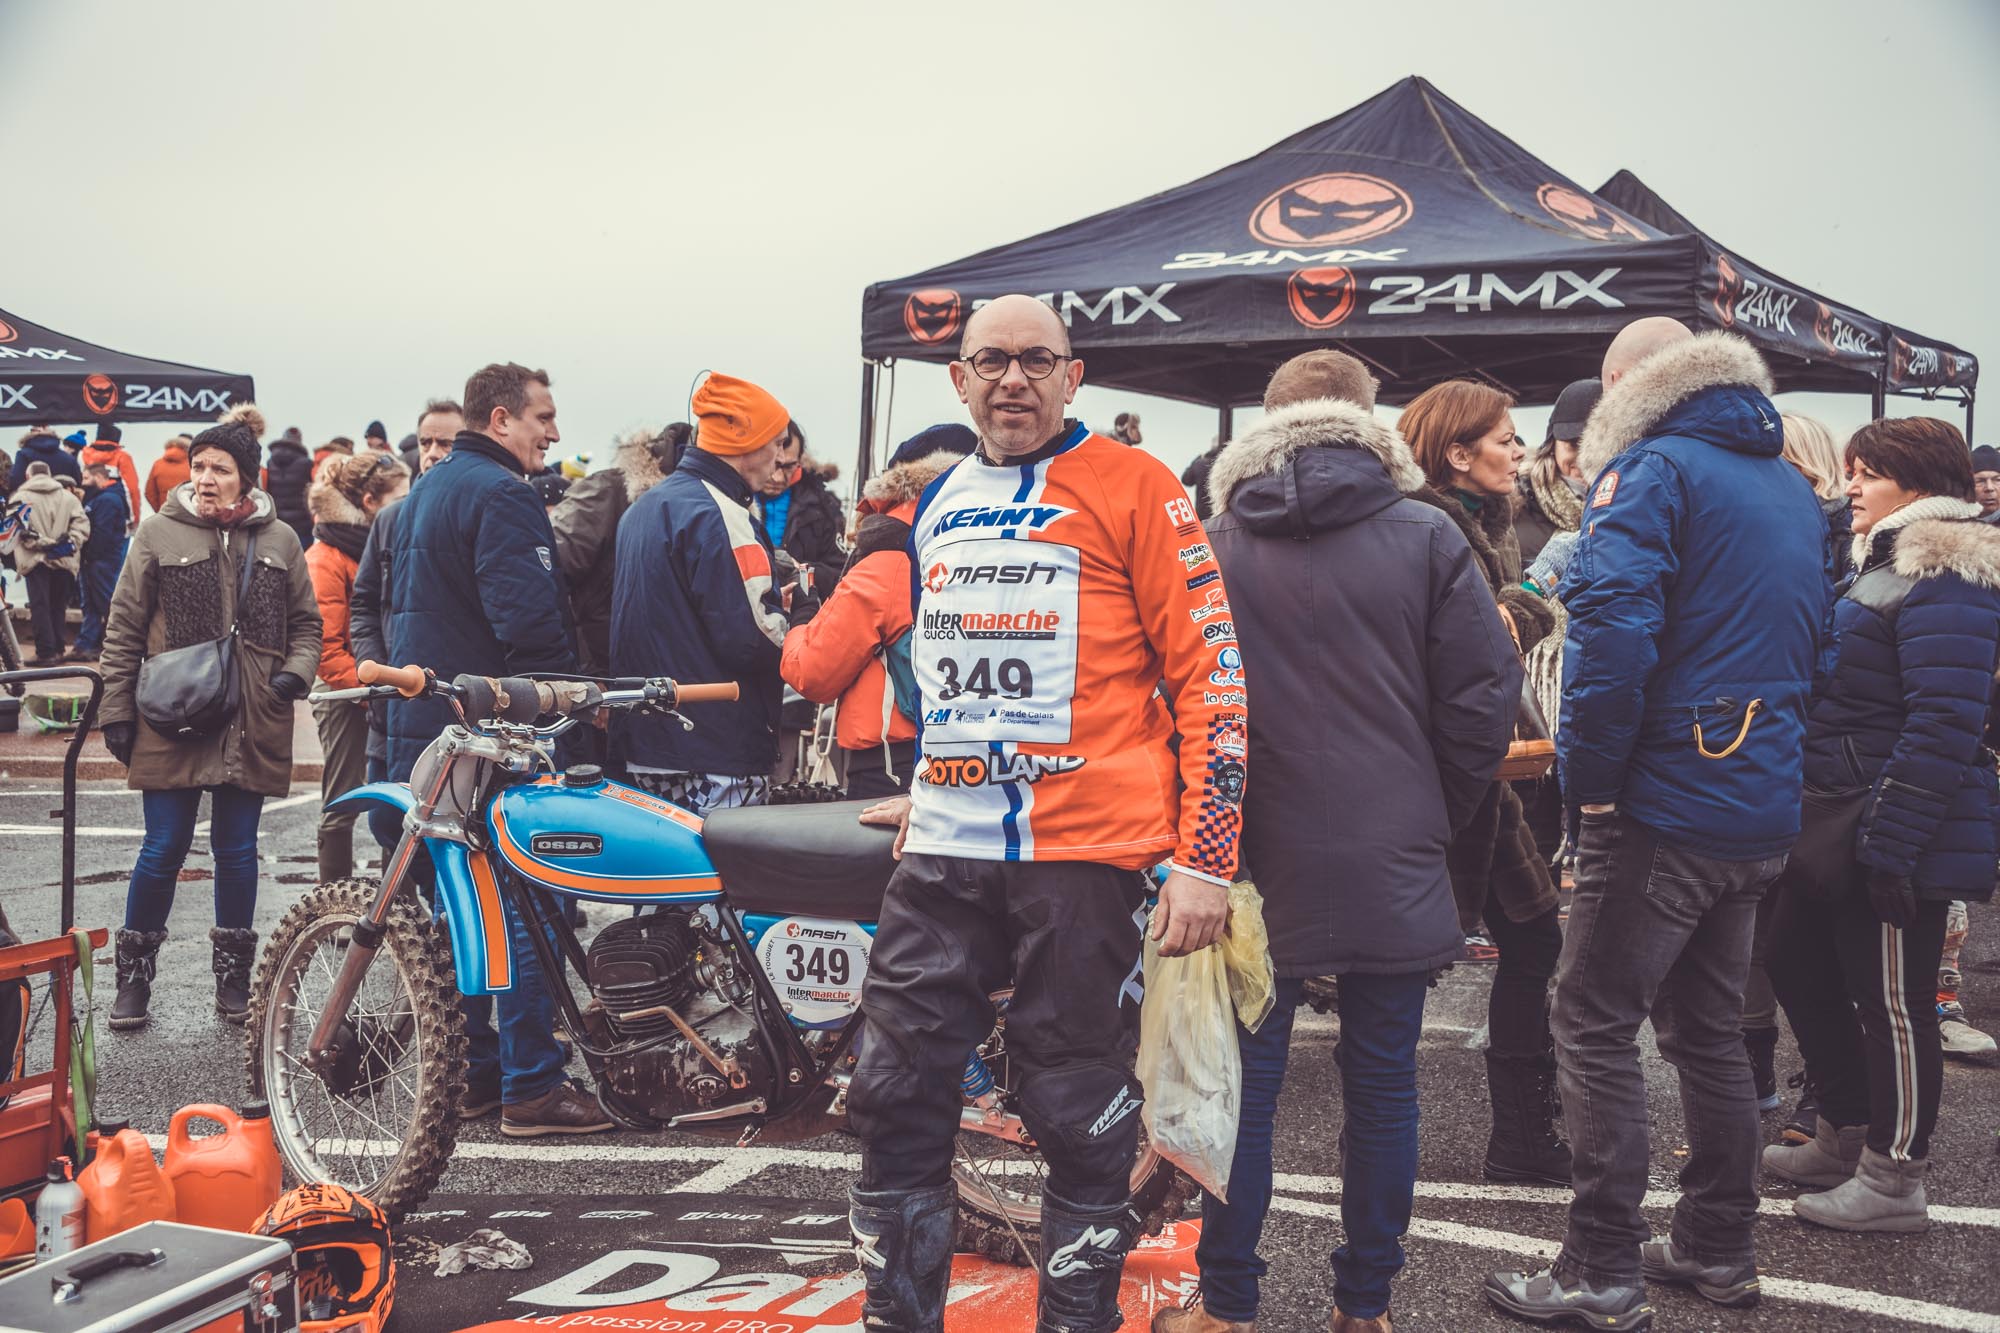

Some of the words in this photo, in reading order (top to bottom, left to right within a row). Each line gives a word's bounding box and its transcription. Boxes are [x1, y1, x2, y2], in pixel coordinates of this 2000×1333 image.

[1162, 248, 1408, 270] 24MX
[1367, 267, 1626, 315] 24MX
[1734, 279, 1798, 336] 24MX
[125, 384, 232, 411] 24MX
[932, 506, 1065, 538] KENNY
[923, 630, 957, 641] CUCQ
[936, 657, 1033, 701] 349
[538, 841, 595, 850] OSSA
[765, 939, 775, 970] TOUQUET
[785, 943, 850, 986] 349
[1088, 1085, 1129, 1137] THOR
[513, 1311, 566, 1323] La
[559, 1314, 702, 1333] passion
